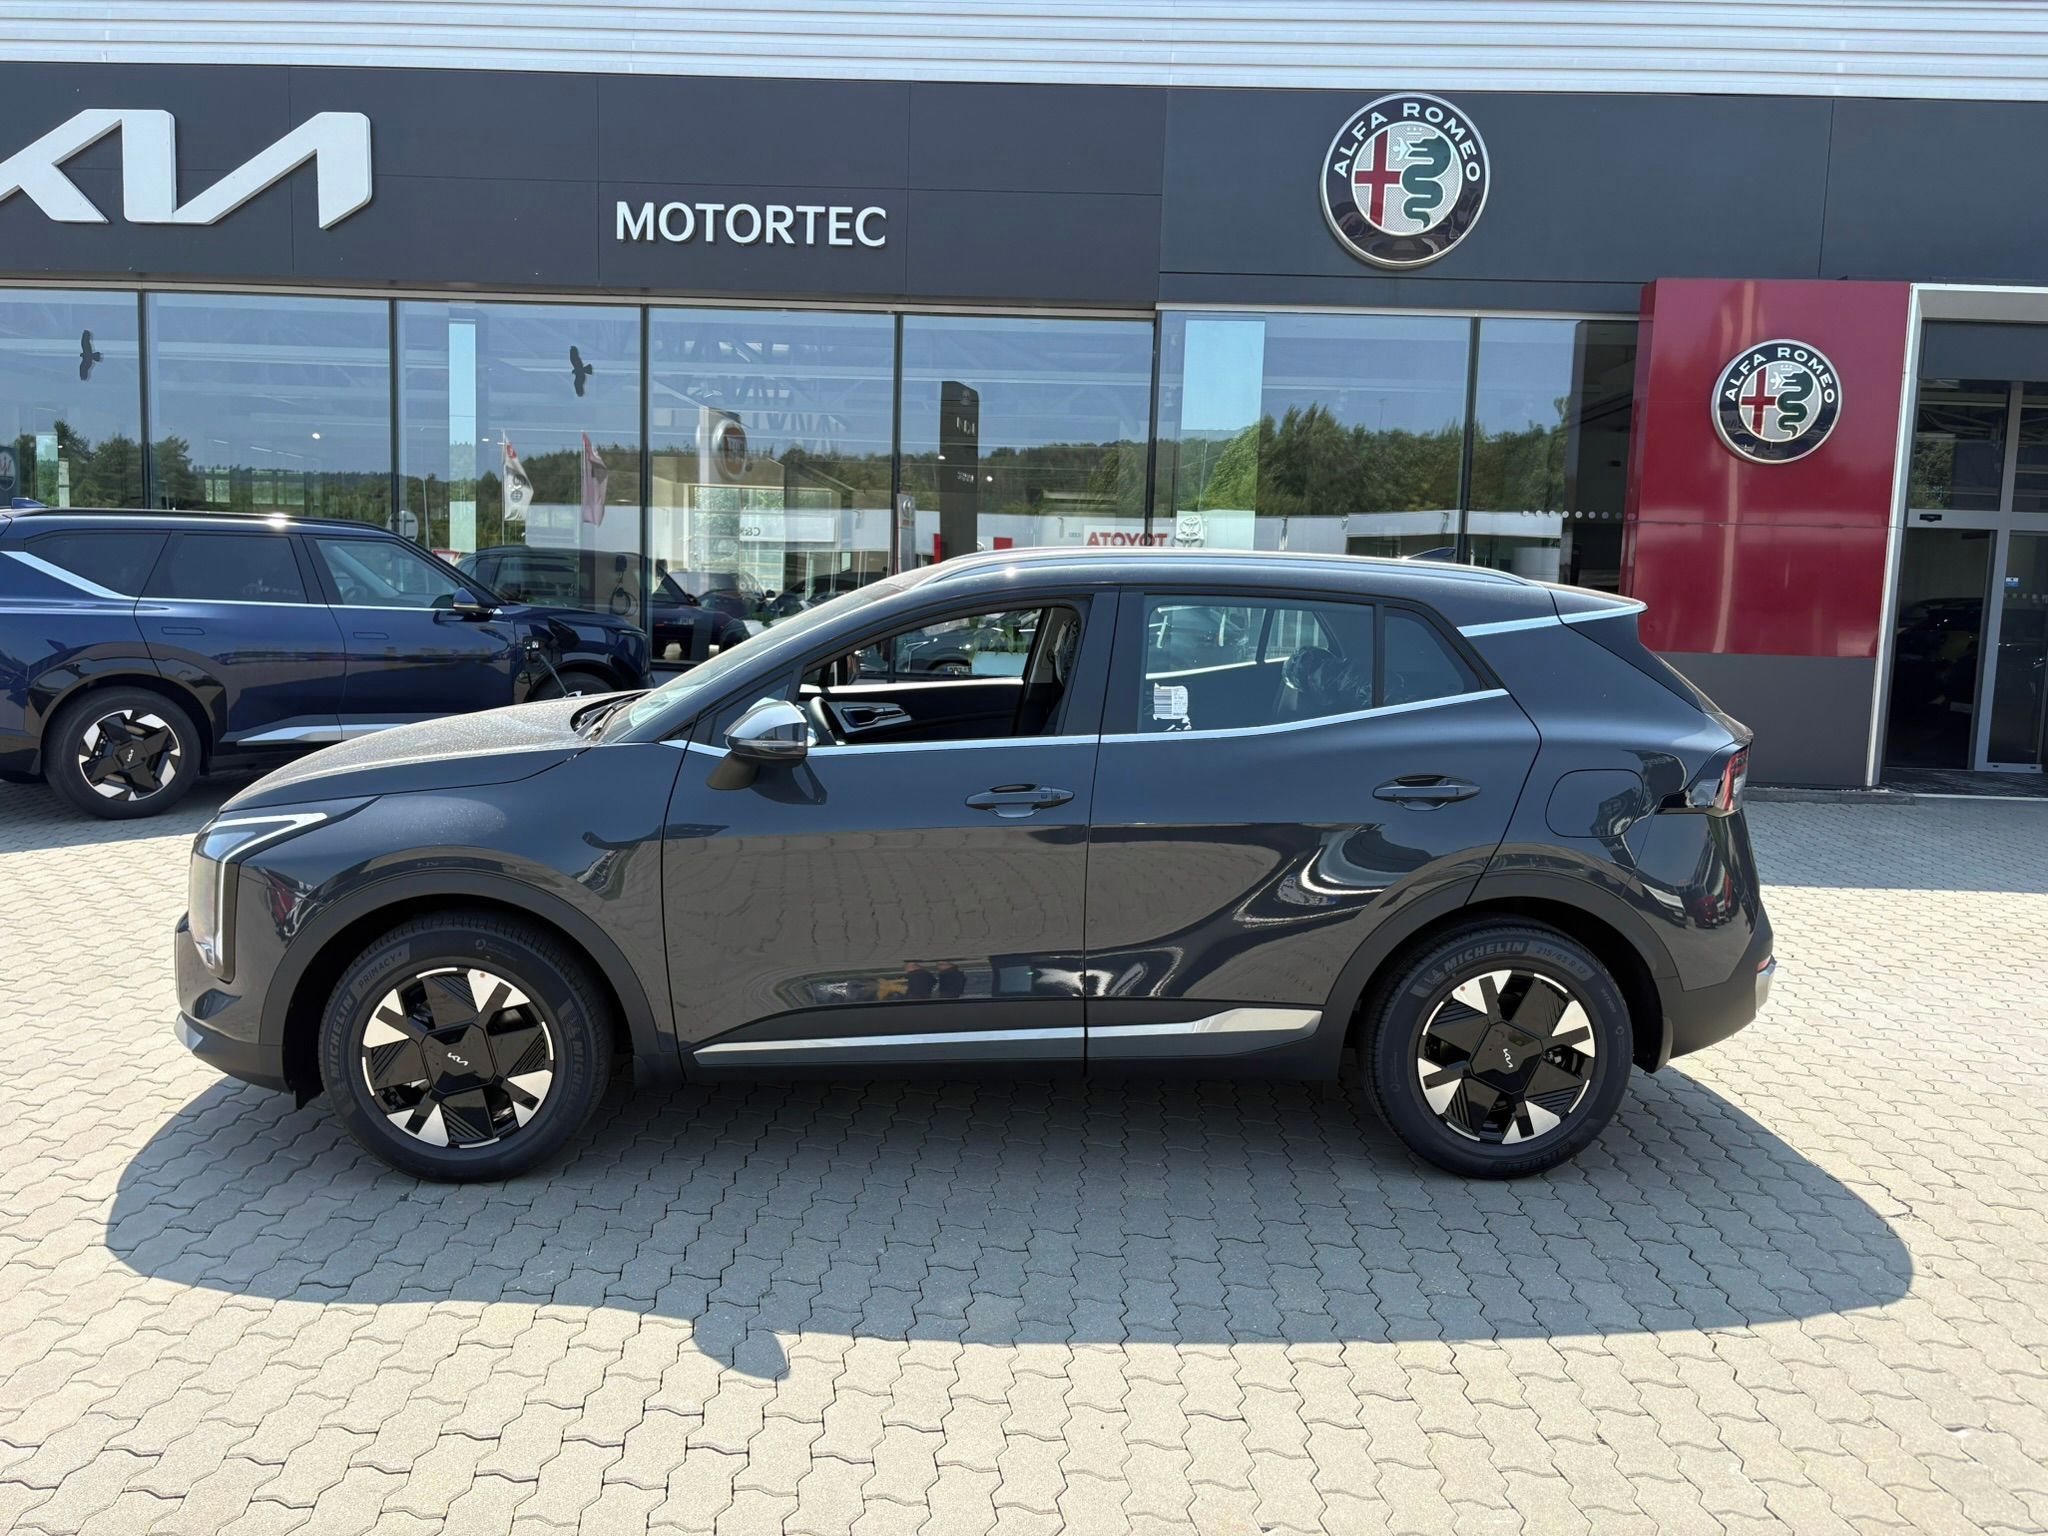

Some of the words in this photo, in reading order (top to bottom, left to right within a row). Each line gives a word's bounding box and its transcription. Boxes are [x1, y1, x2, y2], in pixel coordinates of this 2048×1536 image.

[1334, 111, 1388, 178] ALFA
[1402, 102, 1481, 182] ROMEO
[616, 200, 888, 248] MOTORTEC
[1725, 353, 1767, 402] ALFA
[1777, 347, 1836, 404] ROMEO
[358, 953, 396, 988] PRIMACY
[1443, 941, 1525, 973] MICHELIN
[329, 994, 354, 1079] MICHELIN
